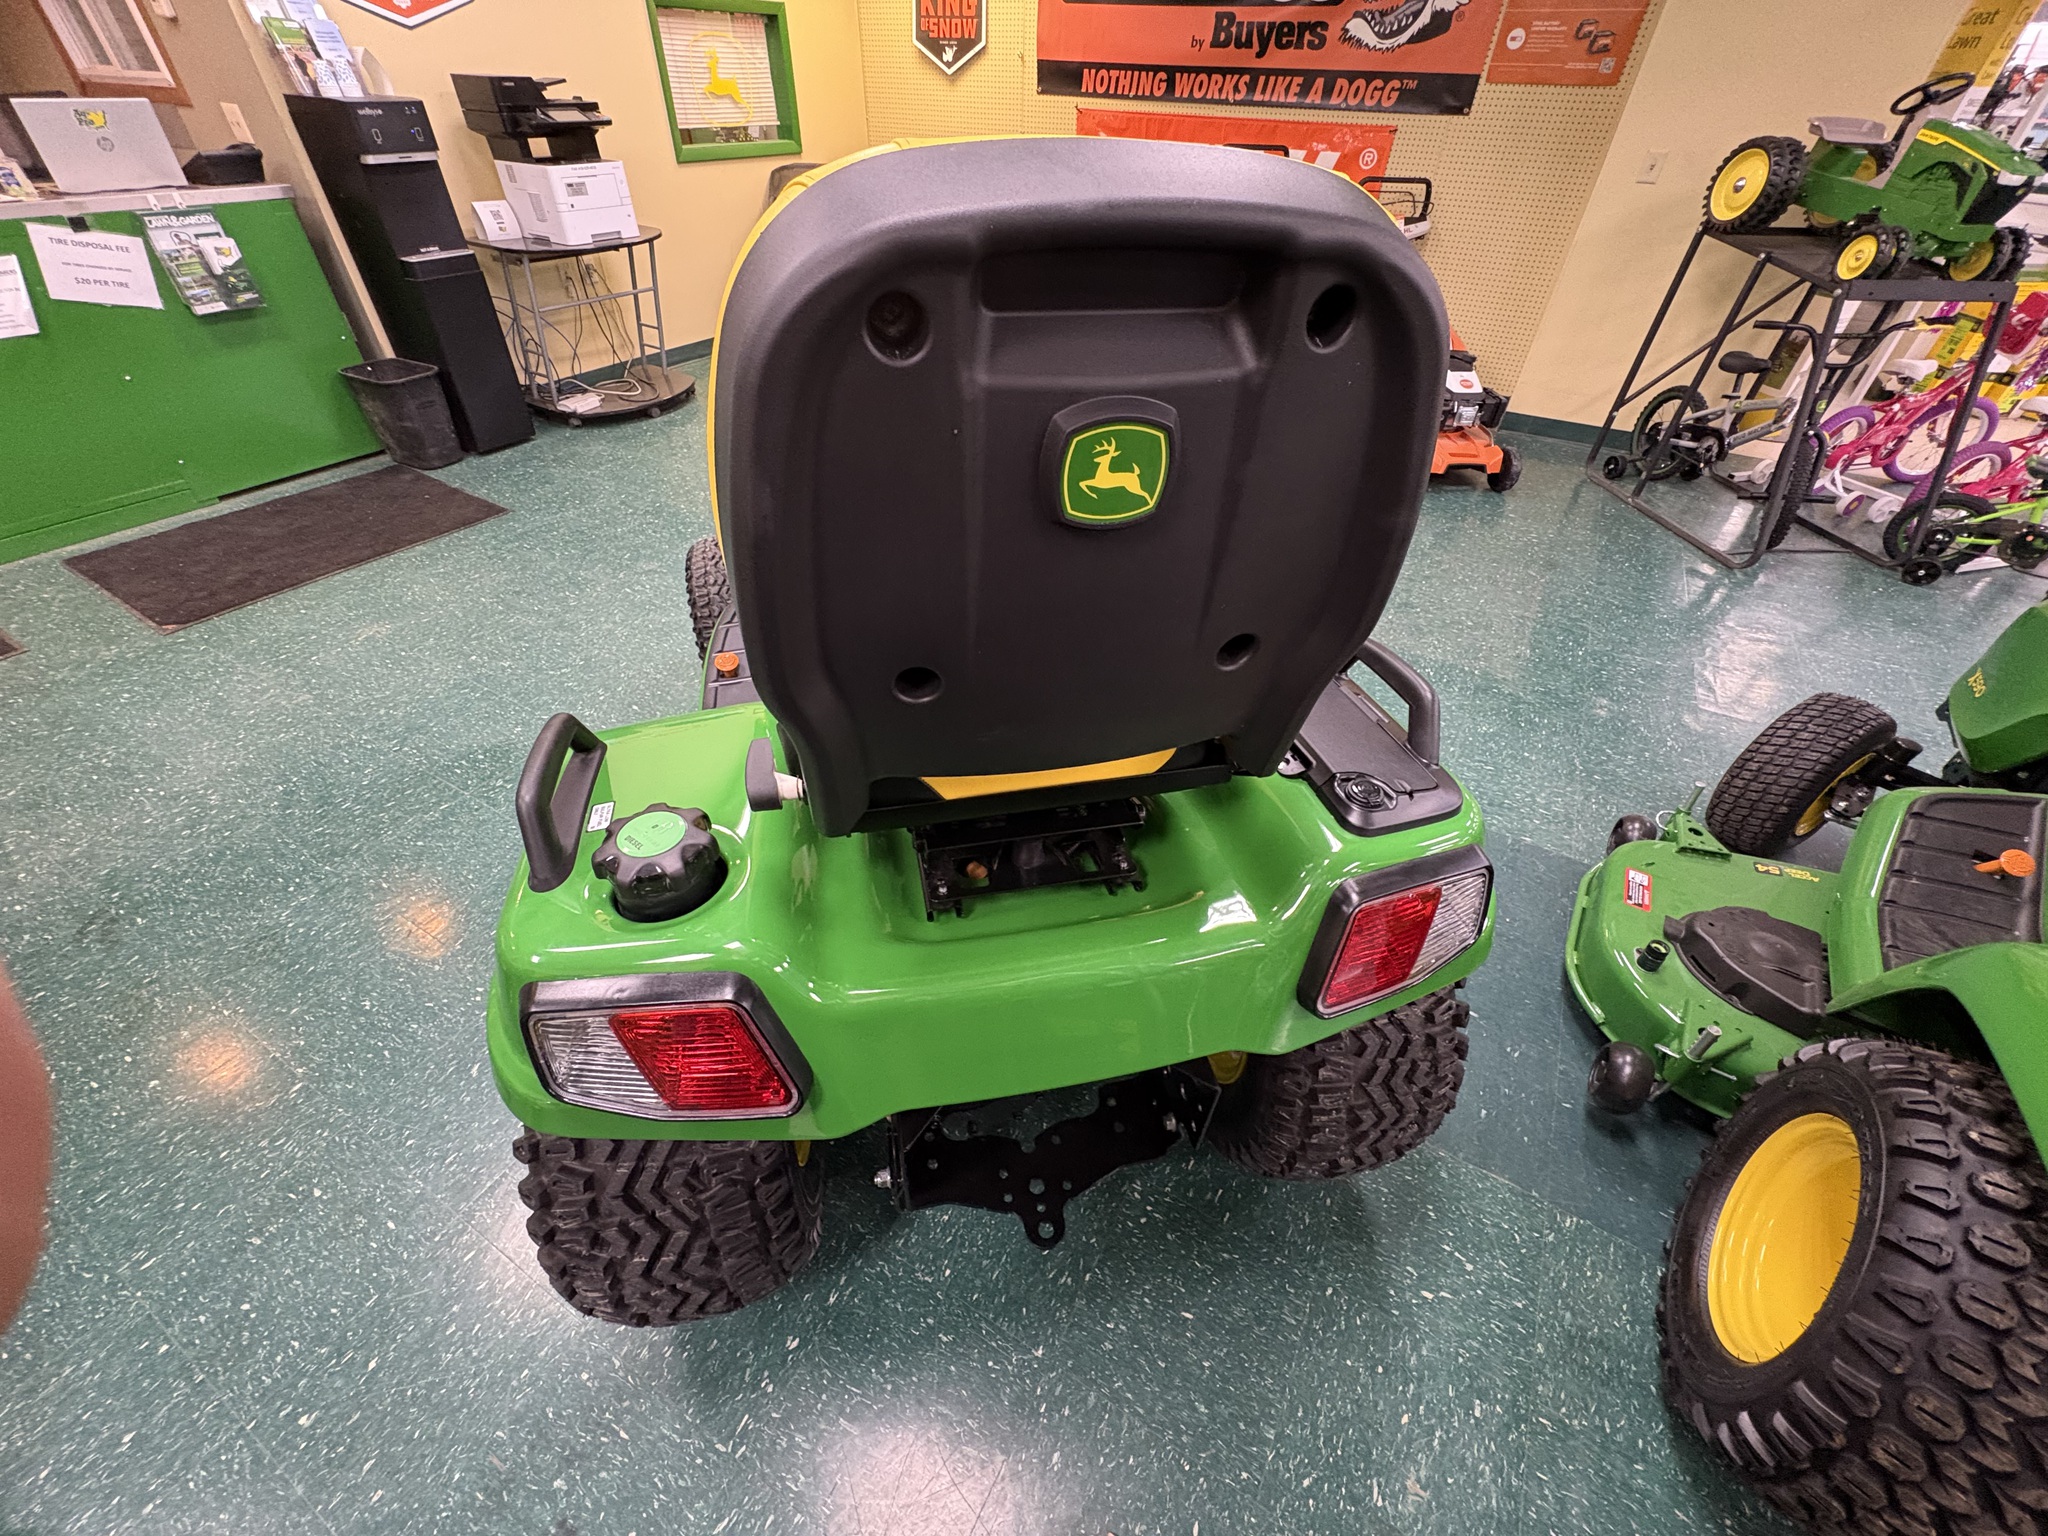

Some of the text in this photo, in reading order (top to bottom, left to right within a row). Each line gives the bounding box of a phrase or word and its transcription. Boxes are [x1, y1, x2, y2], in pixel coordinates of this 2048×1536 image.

[920, 0, 977, 16] KING
[928, 18, 979, 38] SNOW
[1190, 11, 1329, 59] by Buyers
[1081, 68, 1168, 97] NOTHING
[1174, 72, 1250, 101] WORKS
[1253, 74, 1304, 103] LIKE
[1304, 78, 1325, 104] A
[48, 236, 131, 254] TIRE DISPOSAL FEE
[74, 276, 130, 289] $20 PER TIRE
[624, 835, 643, 850] DIESEL
[1755, 864, 1780, 874] 54
